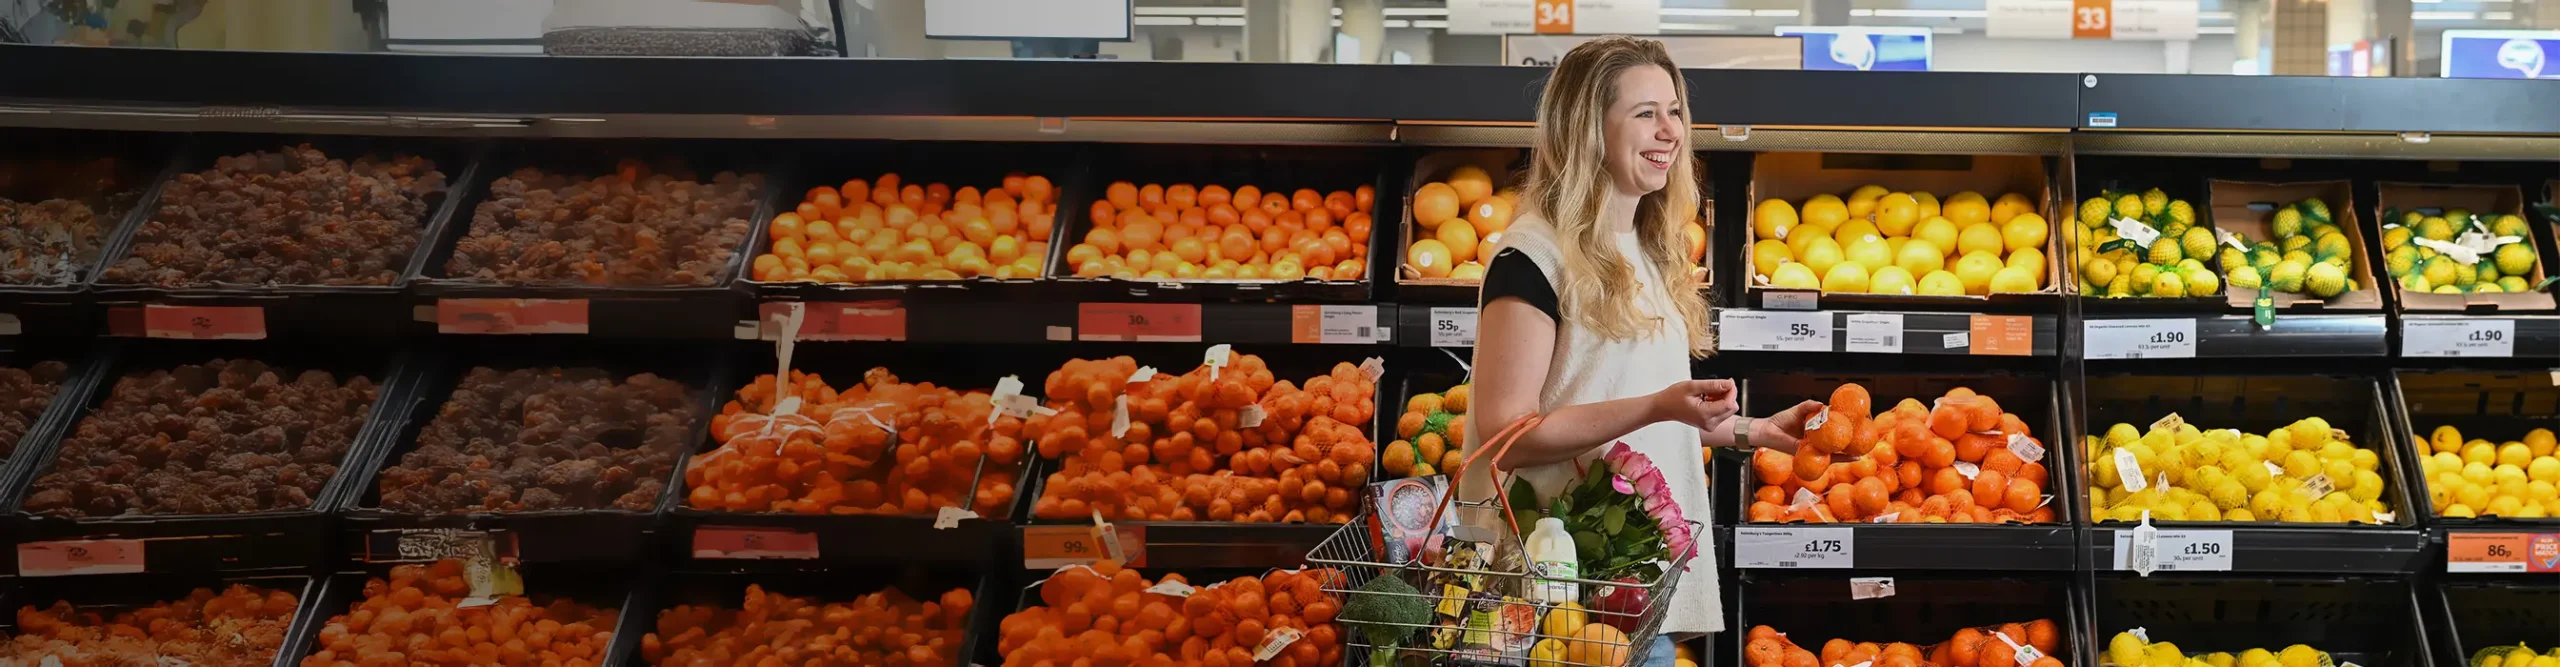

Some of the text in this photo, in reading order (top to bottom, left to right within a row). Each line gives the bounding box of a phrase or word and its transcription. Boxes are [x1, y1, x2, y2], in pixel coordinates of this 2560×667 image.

[1537, 3, 1570, 25] 34
[2077, 7, 2105, 30] 33
[1438, 320, 1459, 332] 55p
[1791, 323, 1816, 337] 55p
[2150, 331, 2184, 343] £1.90
[2469, 330, 2502, 341] £1.90
[1063, 541, 1088, 553] 99p
[1805, 540, 1841, 552] £1.75
[2184, 543, 2220, 555] £1.50
[2487, 544, 2512, 558] 86p
